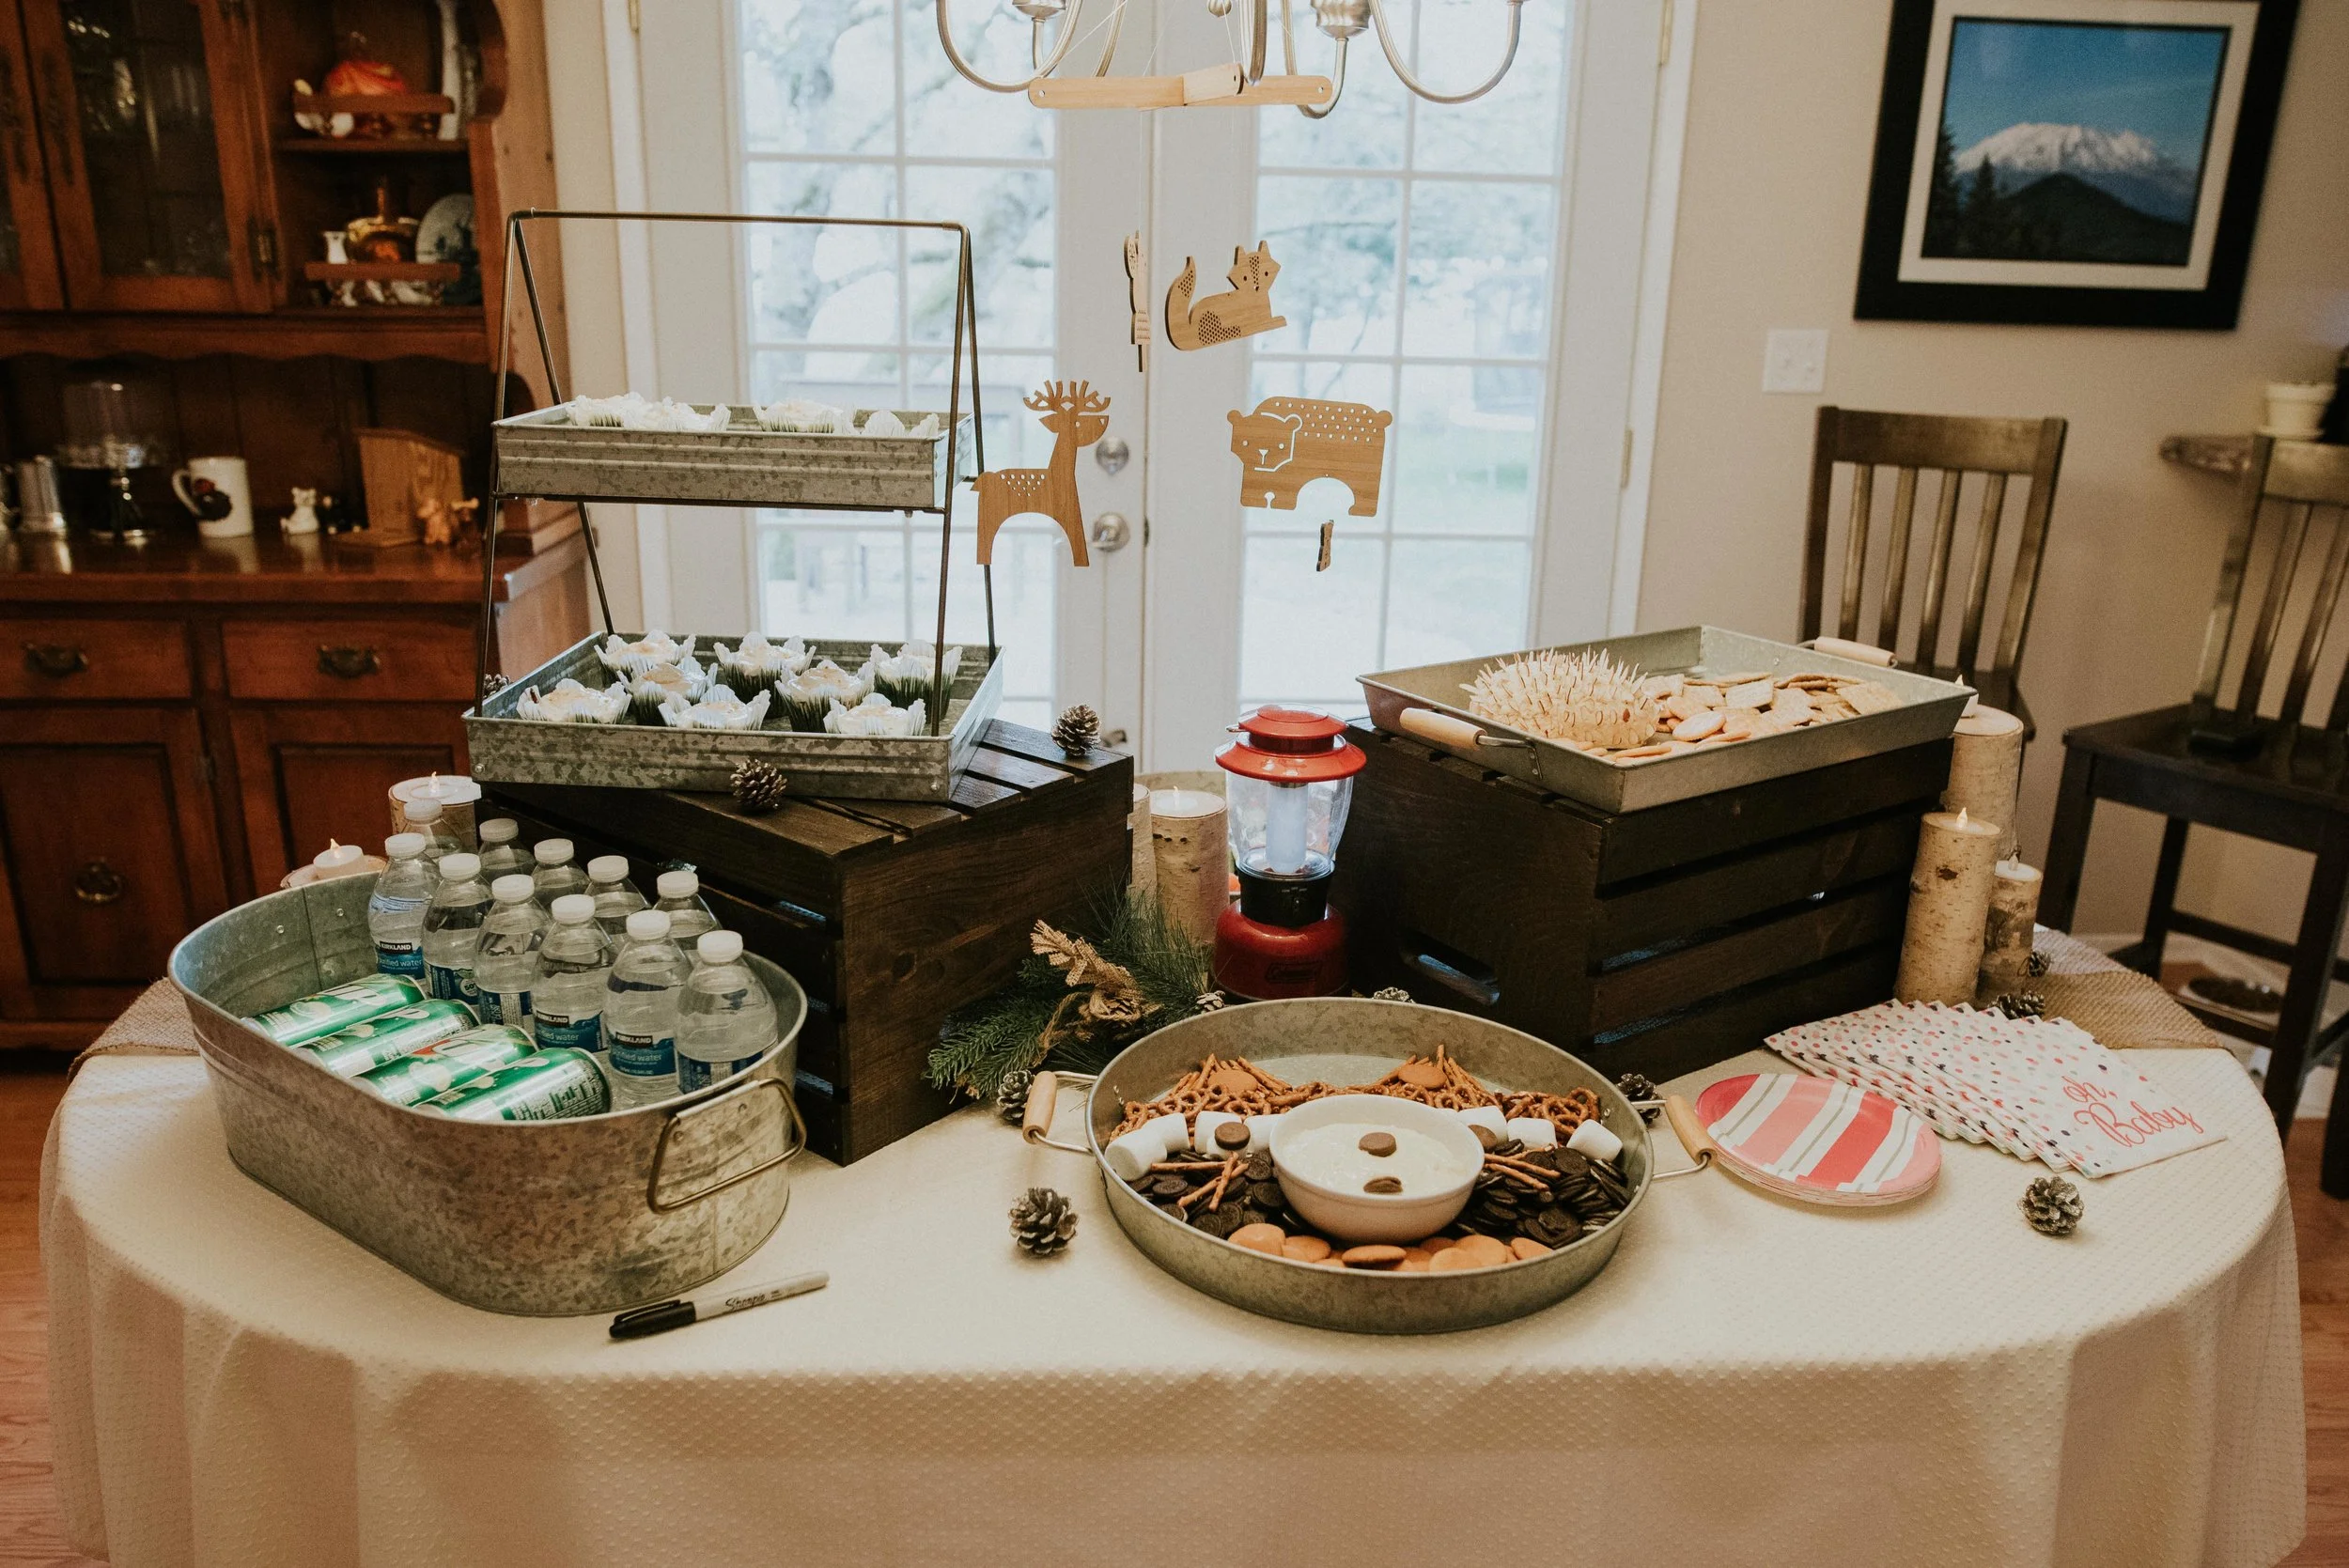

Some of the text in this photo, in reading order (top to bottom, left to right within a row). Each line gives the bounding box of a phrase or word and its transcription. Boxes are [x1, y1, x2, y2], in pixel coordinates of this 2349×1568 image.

[537, 1013, 568, 1023] KIRKLAND
[616, 1034, 652, 1044] KIRKLAND
[2073, 1099, 2203, 1148] Baby
[724, 1293, 766, 1311] Sharpie
